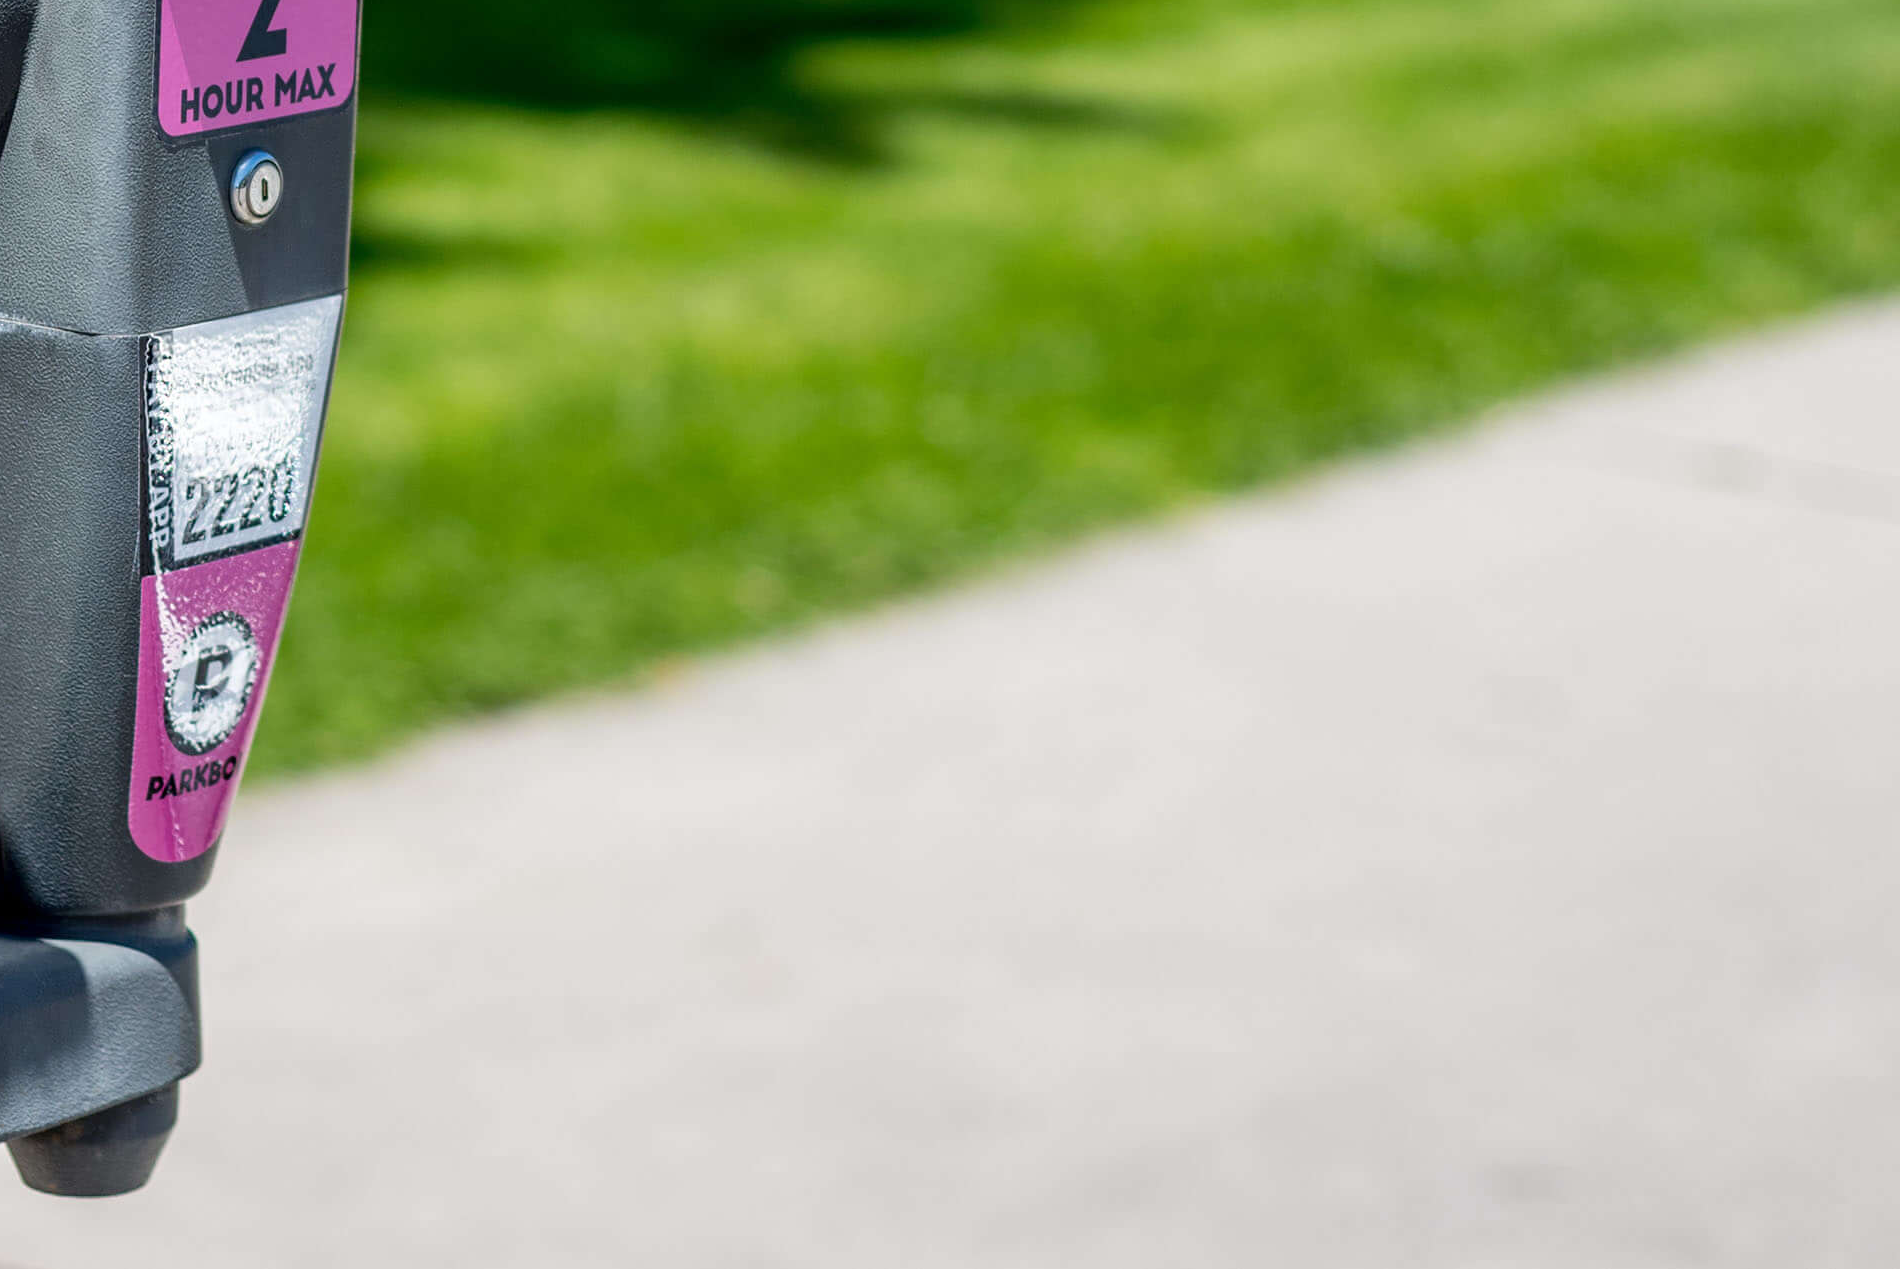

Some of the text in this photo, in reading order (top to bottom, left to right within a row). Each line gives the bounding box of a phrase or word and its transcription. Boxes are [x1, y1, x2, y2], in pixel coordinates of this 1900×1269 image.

[180, 63, 337, 124] HOUR MAX
[151, 485, 173, 547] APP
